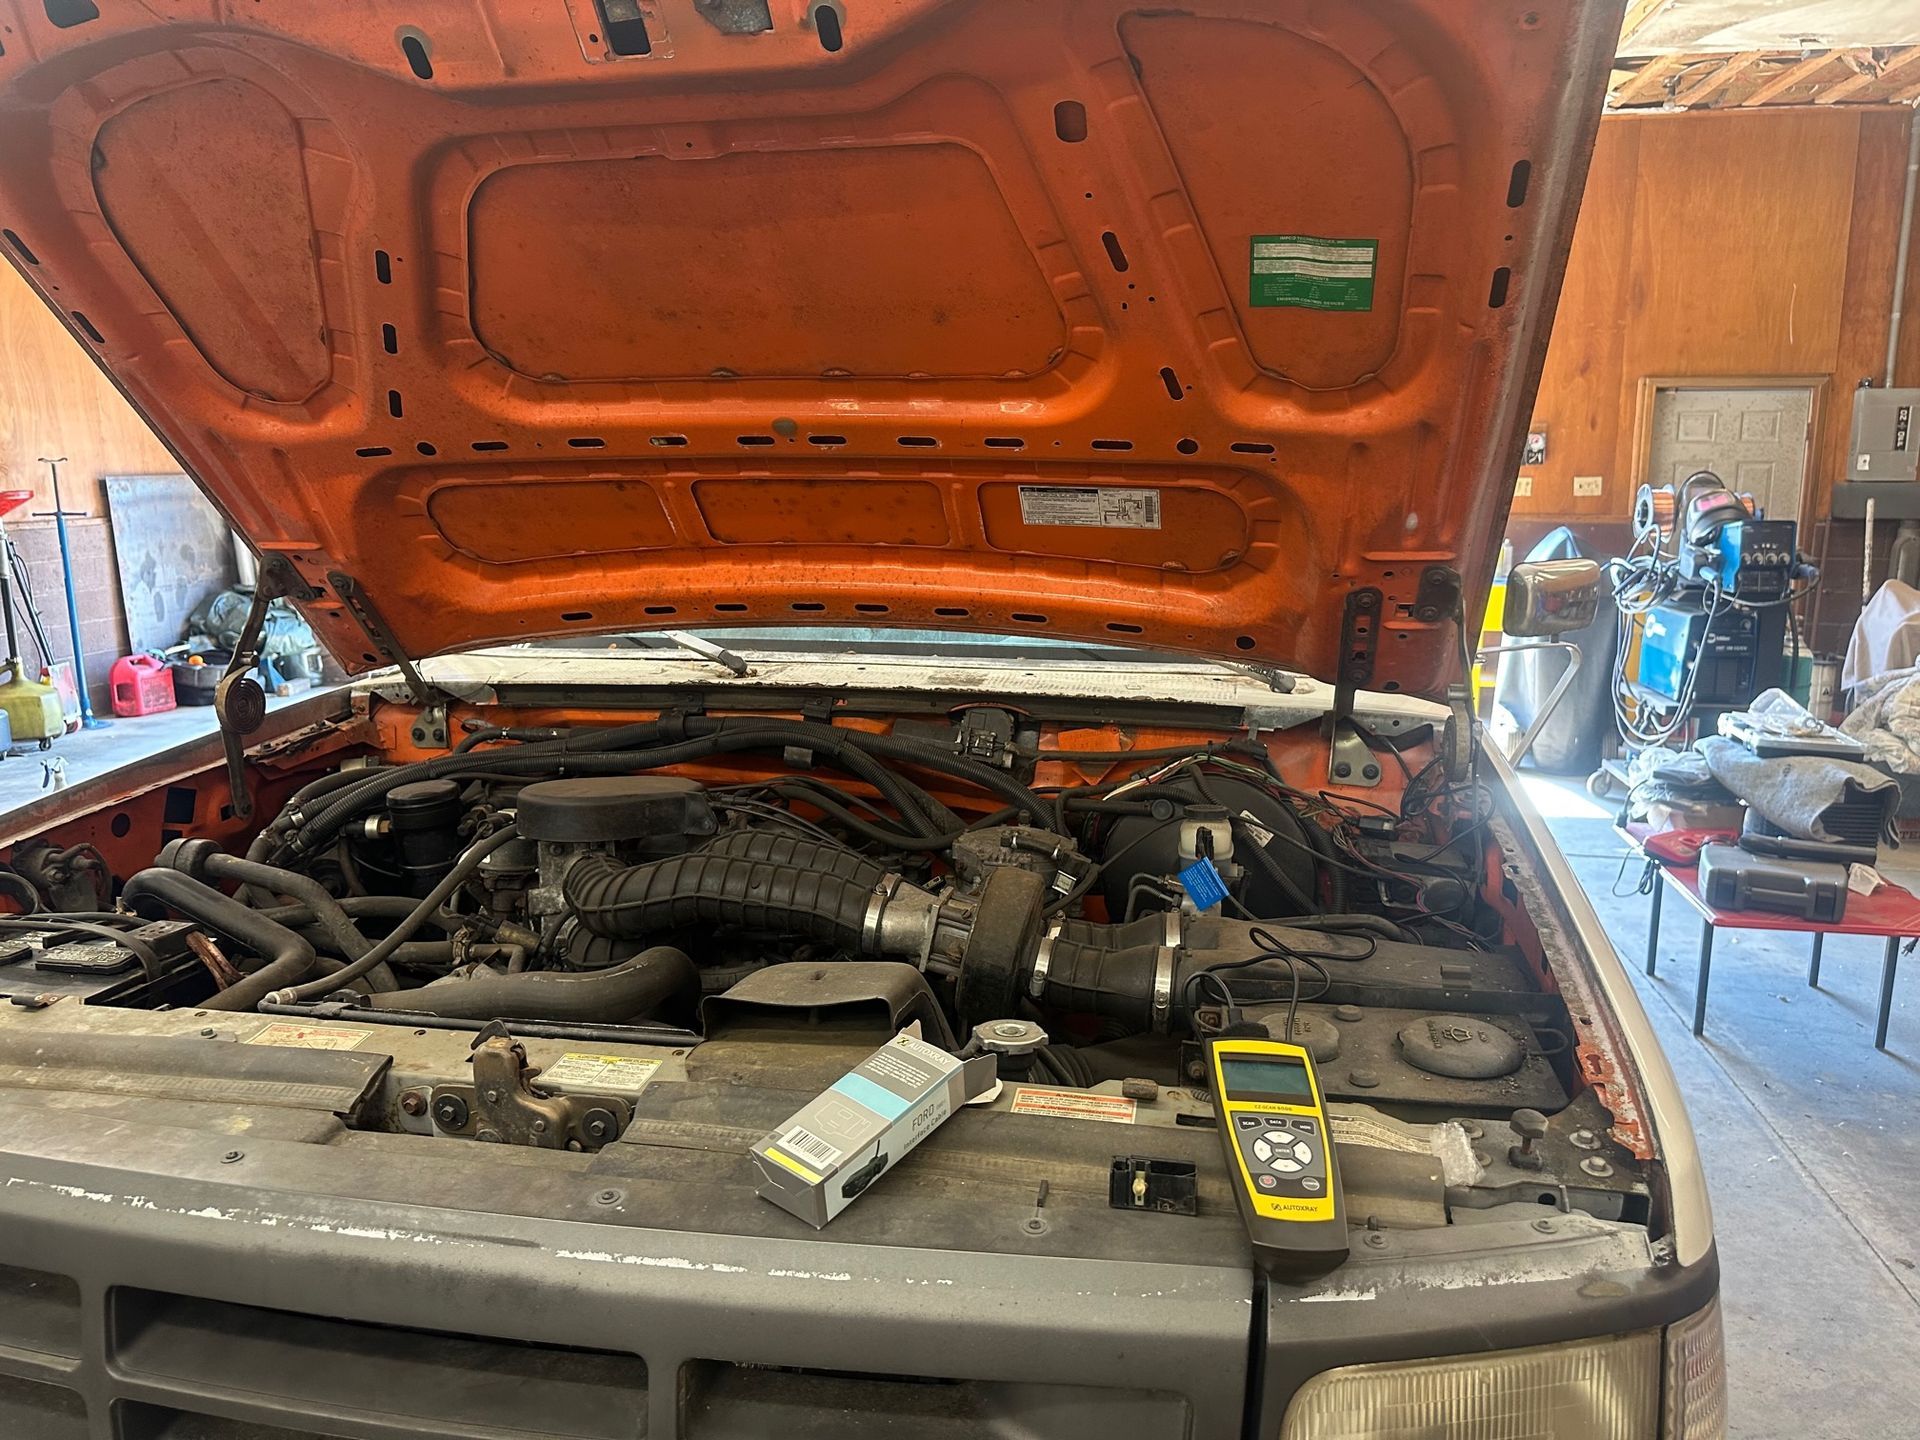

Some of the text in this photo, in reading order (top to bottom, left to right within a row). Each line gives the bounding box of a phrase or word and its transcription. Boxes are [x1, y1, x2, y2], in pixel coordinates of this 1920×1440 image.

[908, 1041, 952, 1065] AUTOXRAY
[903, 1109, 947, 1151] Interface Cable
[911, 1103, 935, 1132] FORD
[1282, 1204, 1318, 1212] AUTOXRAY
